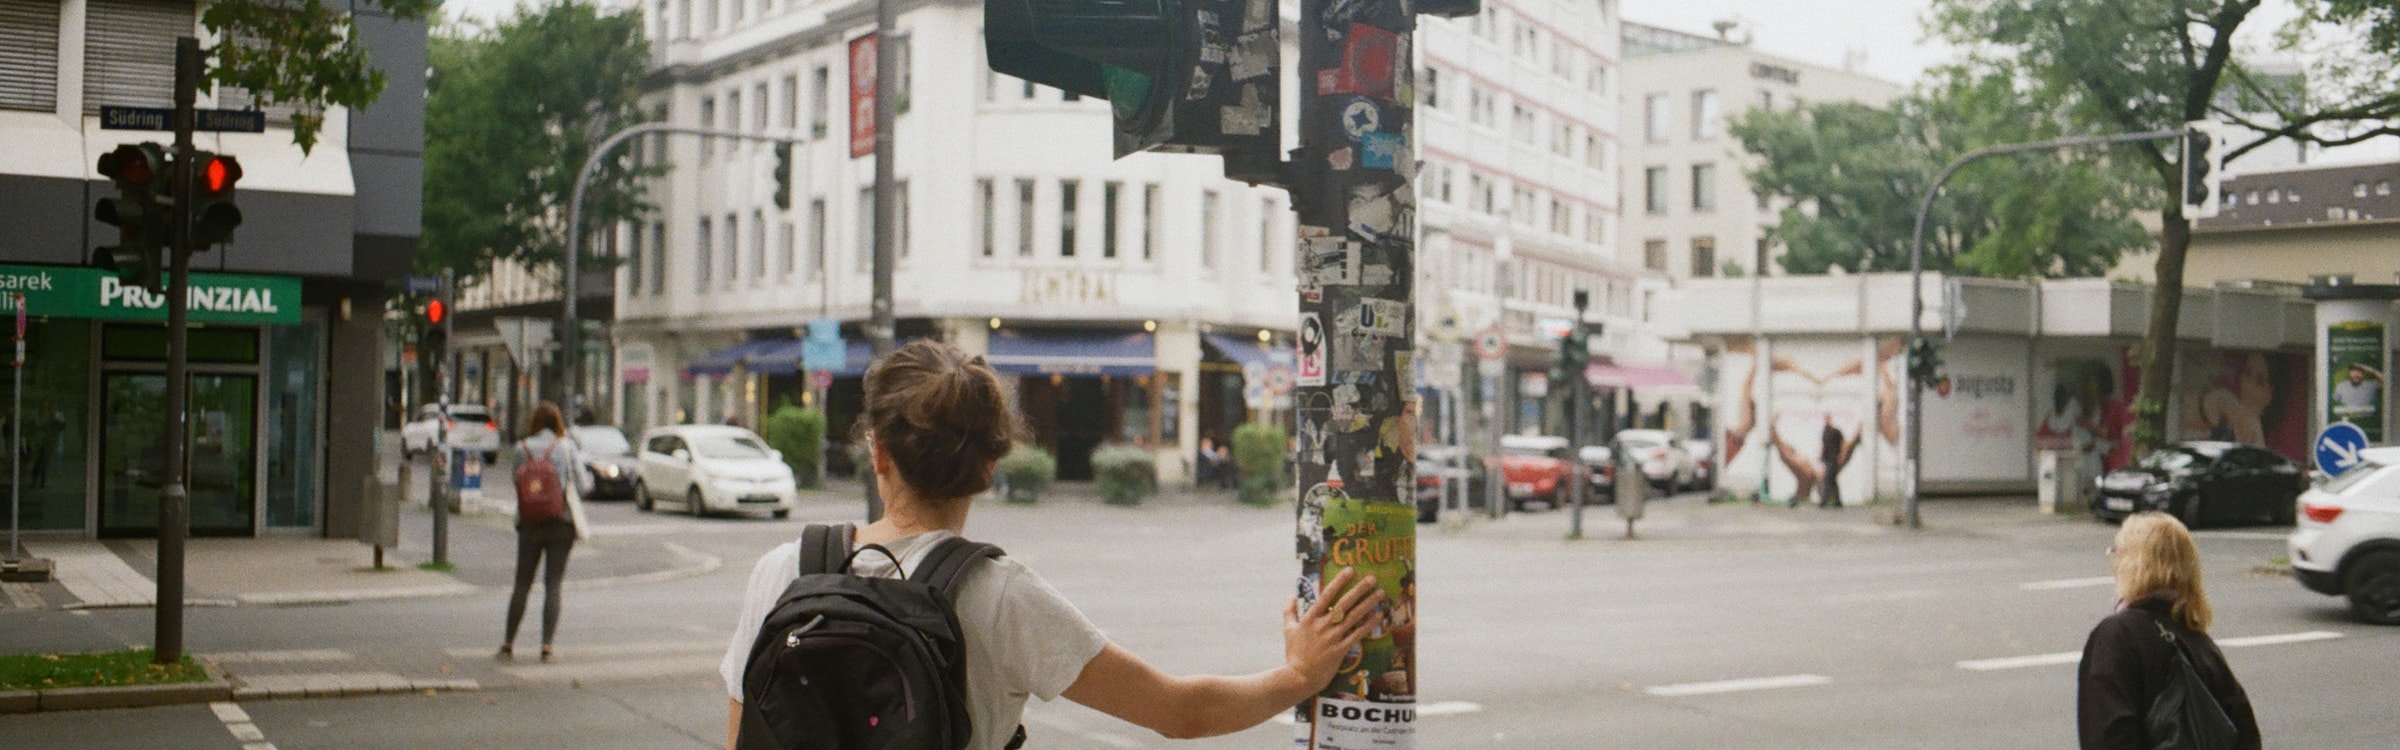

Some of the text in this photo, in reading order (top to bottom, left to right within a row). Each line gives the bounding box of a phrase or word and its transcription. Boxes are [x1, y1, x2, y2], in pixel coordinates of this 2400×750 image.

[110, 109, 163, 130] Südring
[206, 112, 254, 131] Südring
[100, 276, 278, 313] PROINZIAL
